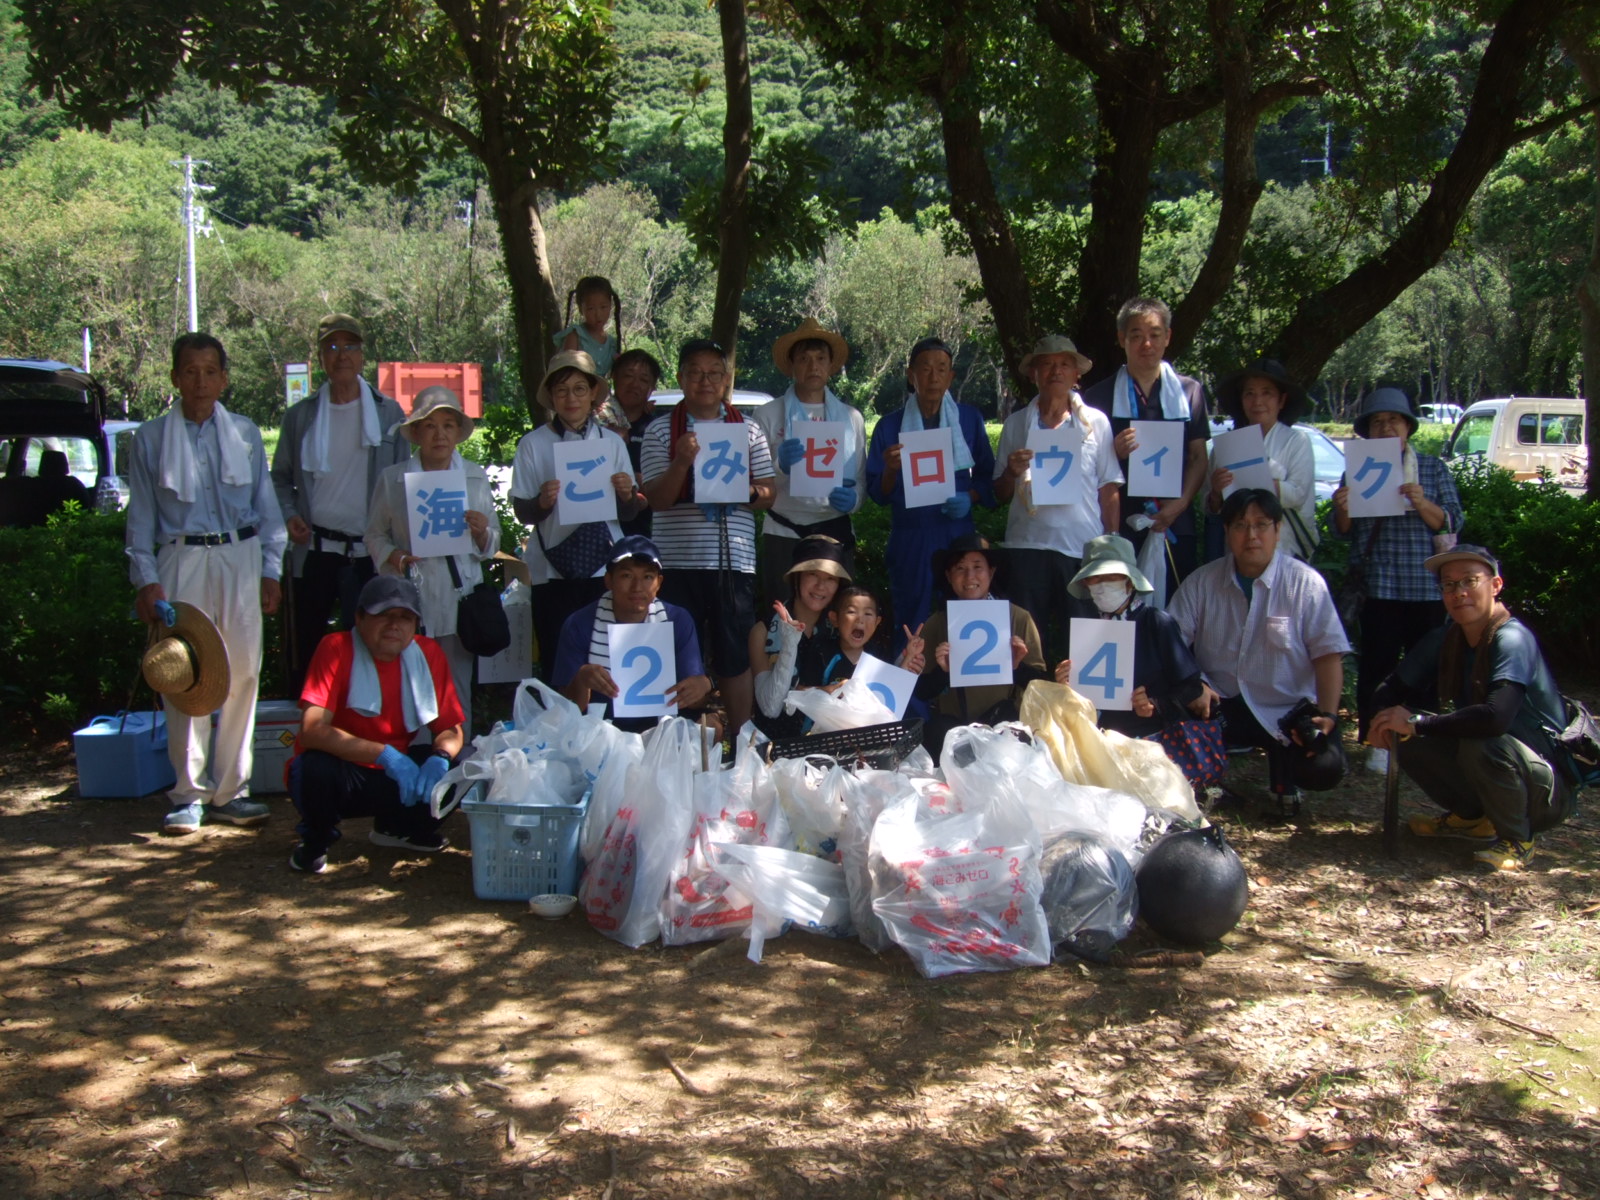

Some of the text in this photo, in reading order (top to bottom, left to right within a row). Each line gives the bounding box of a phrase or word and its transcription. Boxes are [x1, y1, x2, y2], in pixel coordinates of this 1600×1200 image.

[564, 455, 607, 503] ご
[701, 439, 748, 485] み
[802, 438, 838, 479] ゼ
[910, 450, 946, 487] ロ
[1034, 444, 1075, 488] ウ
[1141, 445, 1170, 478] ィ
[1223, 456, 1265, 471] ー
[1354, 456, 1393, 500] ク
[415, 487, 468, 540] 海
[958, 618, 1002, 676] 2
[620, 644, 666, 706] 2
[1078, 641, 1125, 700] 4
[932, 869, 989, 887] 海ごみゼロ
